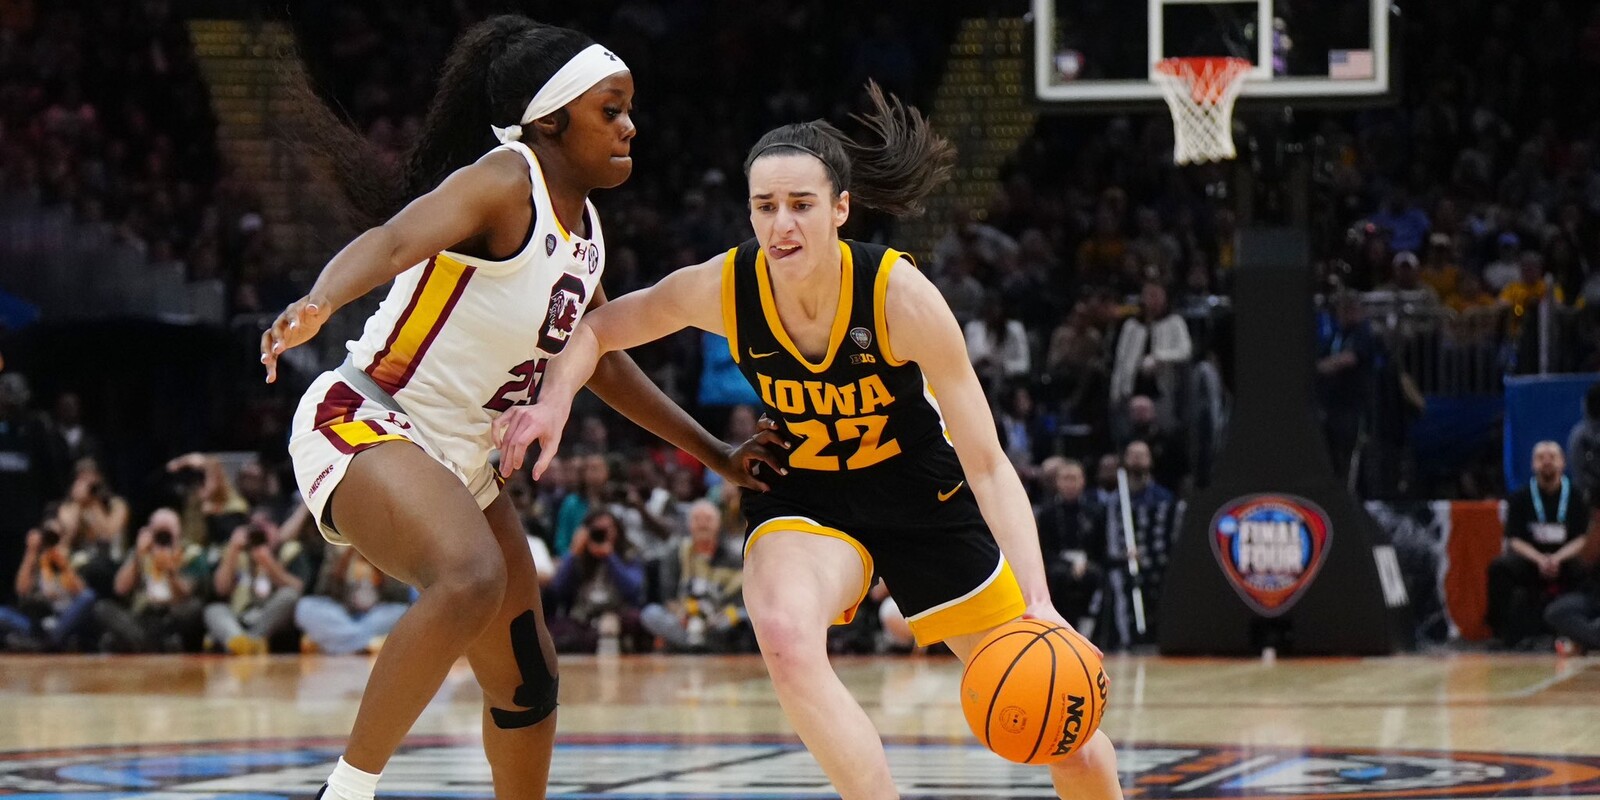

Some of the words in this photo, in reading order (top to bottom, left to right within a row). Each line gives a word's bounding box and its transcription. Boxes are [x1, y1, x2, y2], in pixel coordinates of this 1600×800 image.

[757, 372, 895, 416] IOWA
[783, 415, 902, 471] 22
[1239, 521, 1301, 543] FINAL
[1239, 544, 1302, 573] FOUR
[1051, 695, 1085, 756] NCAA
